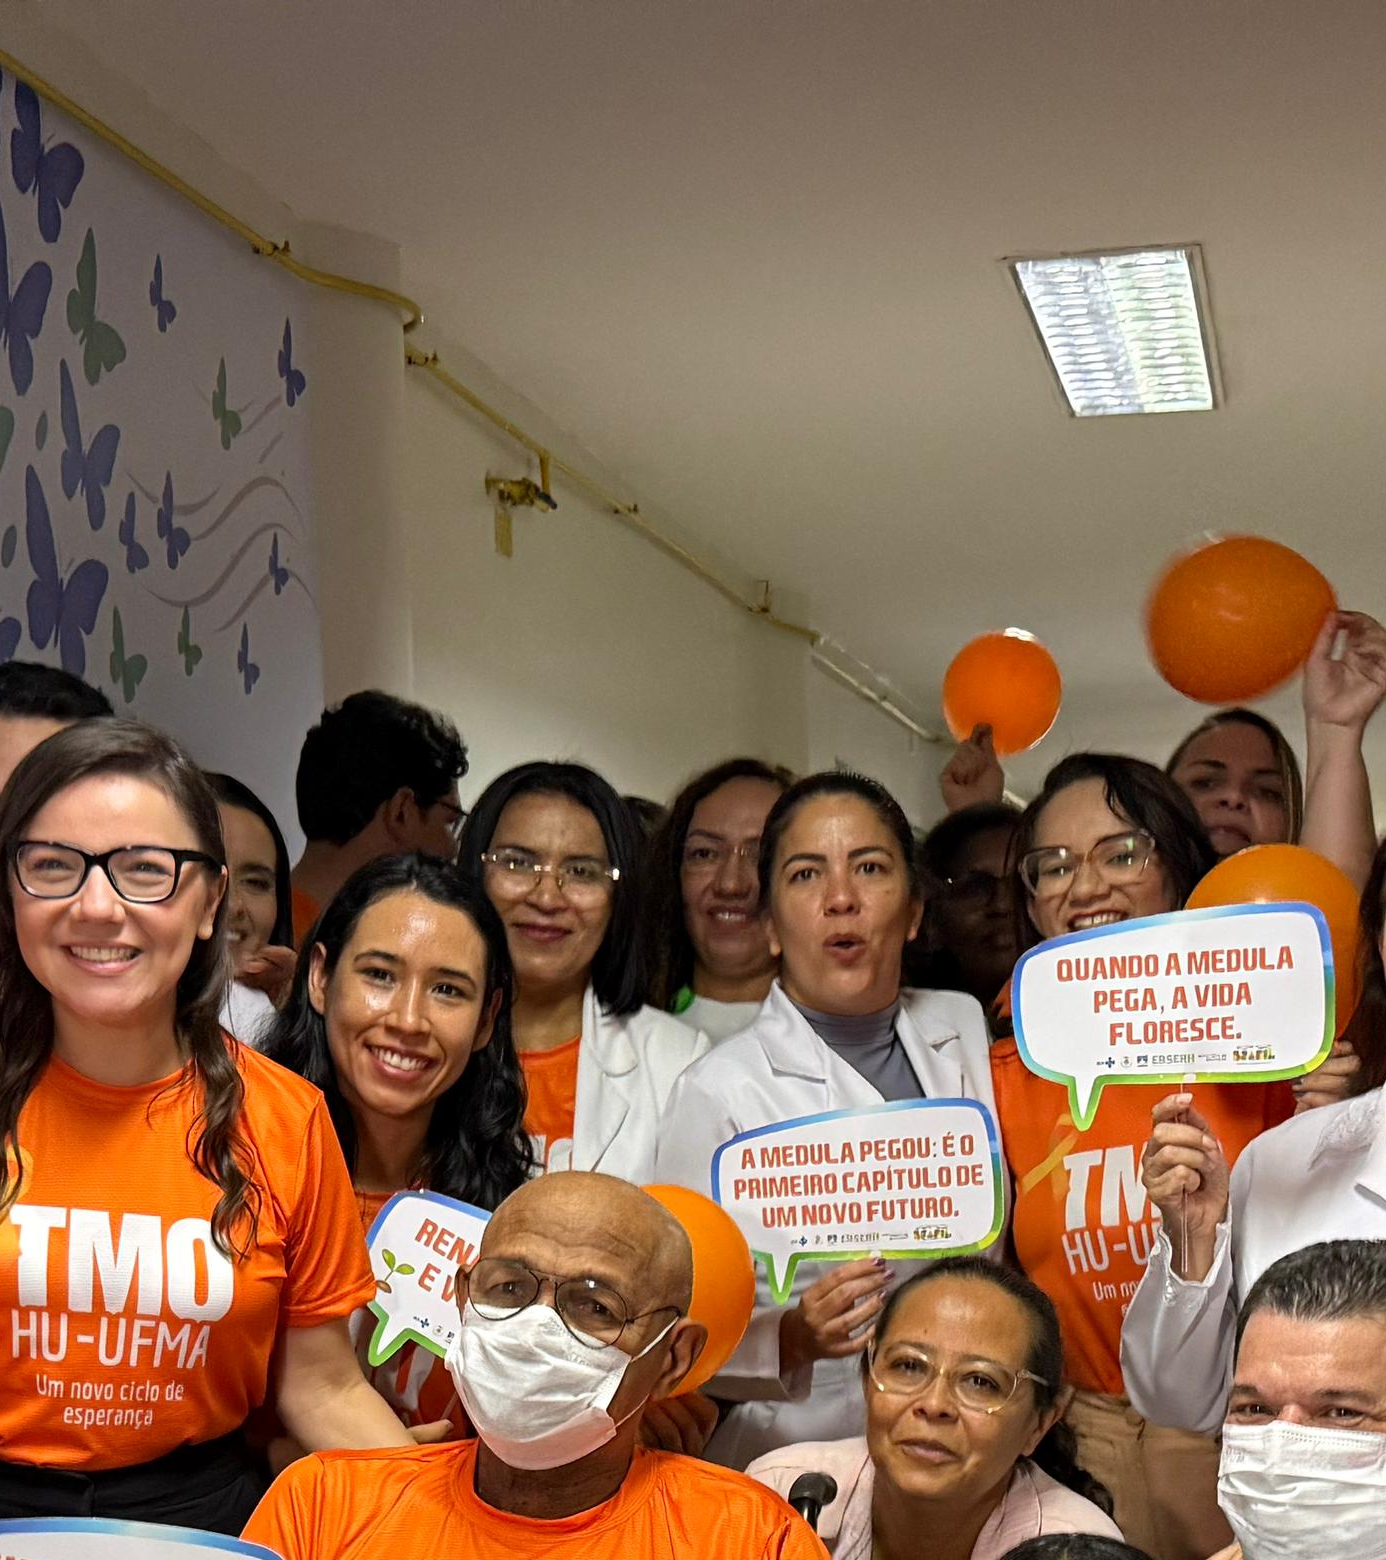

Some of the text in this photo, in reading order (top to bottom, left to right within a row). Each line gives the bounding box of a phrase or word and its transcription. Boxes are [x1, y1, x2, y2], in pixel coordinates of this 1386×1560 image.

[1056, 945, 1294, 982] QUANDO A MEDULA
[1093, 981, 1252, 1014] PEGA, A VIDA
[1109, 1016, 1242, 1046] FLORESCE.
[741, 1132, 974, 1169] A MEDULA PEGOU: É O
[733, 1164, 984, 1200] PRIMEIRO CAPÍTULO DE
[1063, 1141, 1162, 1232] TM
[762, 1196, 959, 1228] UM NOVO FUTURO.
[10, 1204, 234, 1323] TMO
[418, 1263, 441, 1292] E
[1093, 1281, 1117, 1301] Um
[12, 1309, 211, 1369] HU-UFMA
[36, 1374, 184, 1402] Um novo ciclo de
[63, 1406, 154, 1430] esperança
